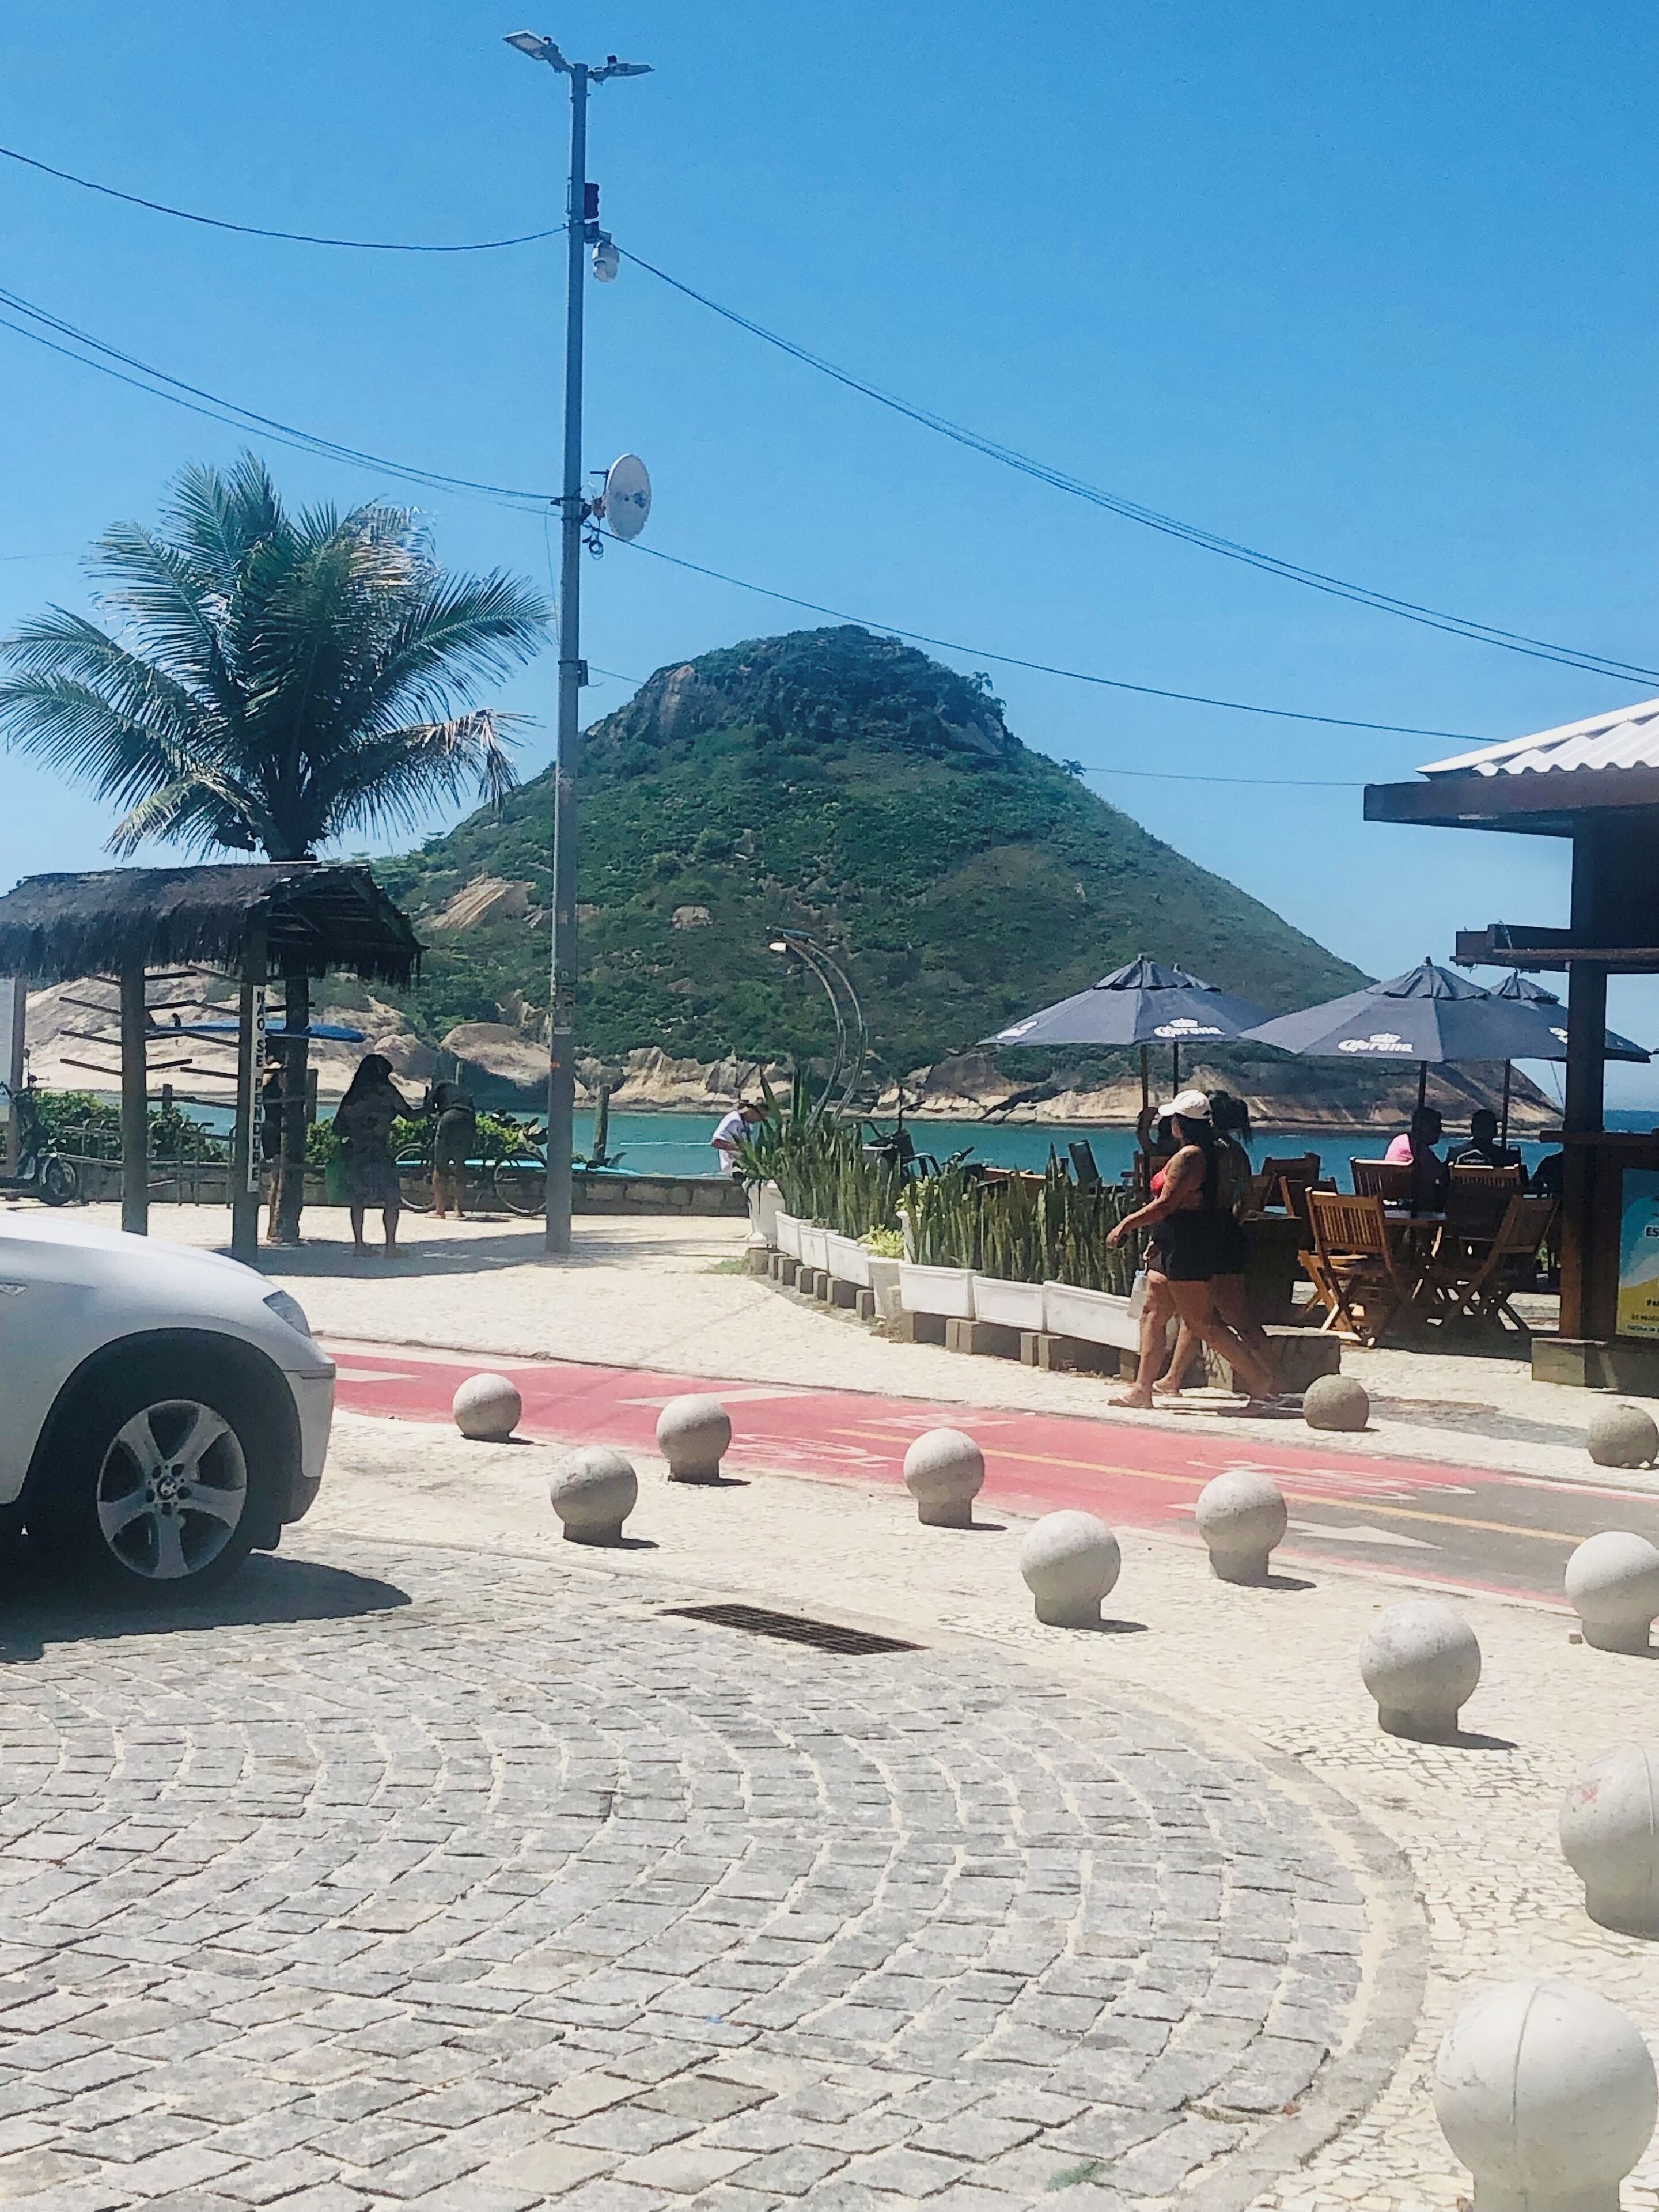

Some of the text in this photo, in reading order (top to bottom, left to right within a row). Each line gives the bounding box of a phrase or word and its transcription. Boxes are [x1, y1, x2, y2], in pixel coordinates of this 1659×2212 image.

[1154, 1025, 1225, 1037] Corona
[256, 1039, 264, 1067] SE
[1338, 1039, 1414, 1053] Corona
